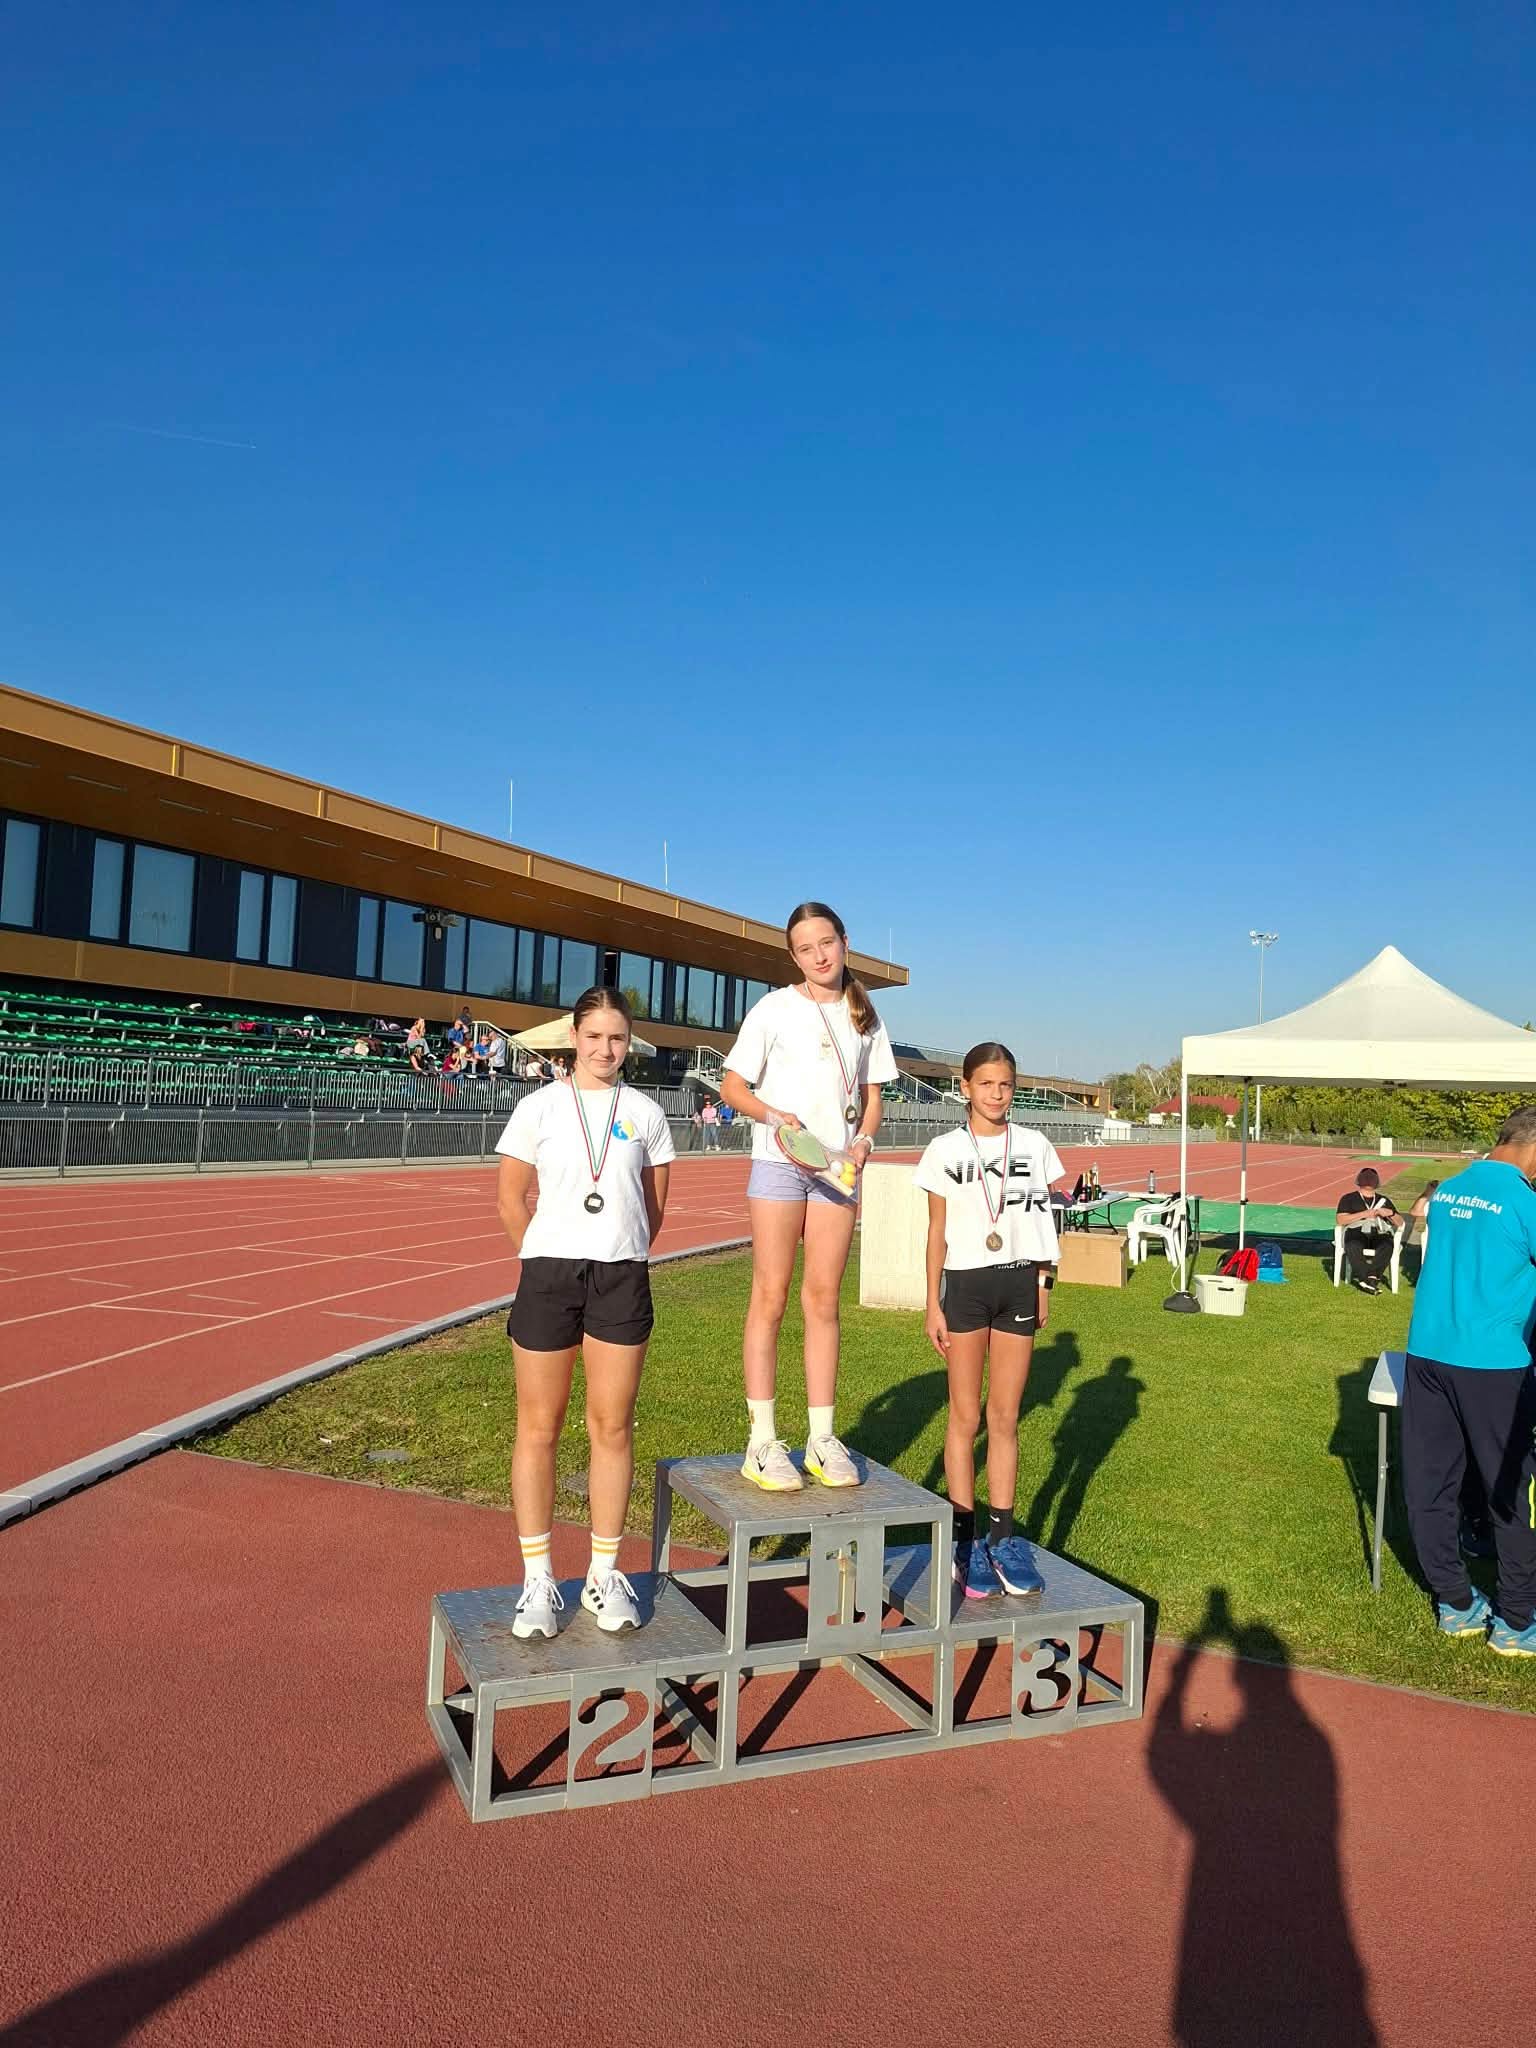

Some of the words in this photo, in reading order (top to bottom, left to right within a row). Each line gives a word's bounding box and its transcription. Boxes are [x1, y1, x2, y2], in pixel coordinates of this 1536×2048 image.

[944, 1154, 1032, 1184] NIKE
[1450, 1207, 1473, 1219] CLUB
[1456, 1195, 1503, 1215] ATLÉTIKAI
[825, 1540, 867, 1626] 1
[1017, 1638, 1071, 1719] 3
[573, 1687, 649, 1782] 2
